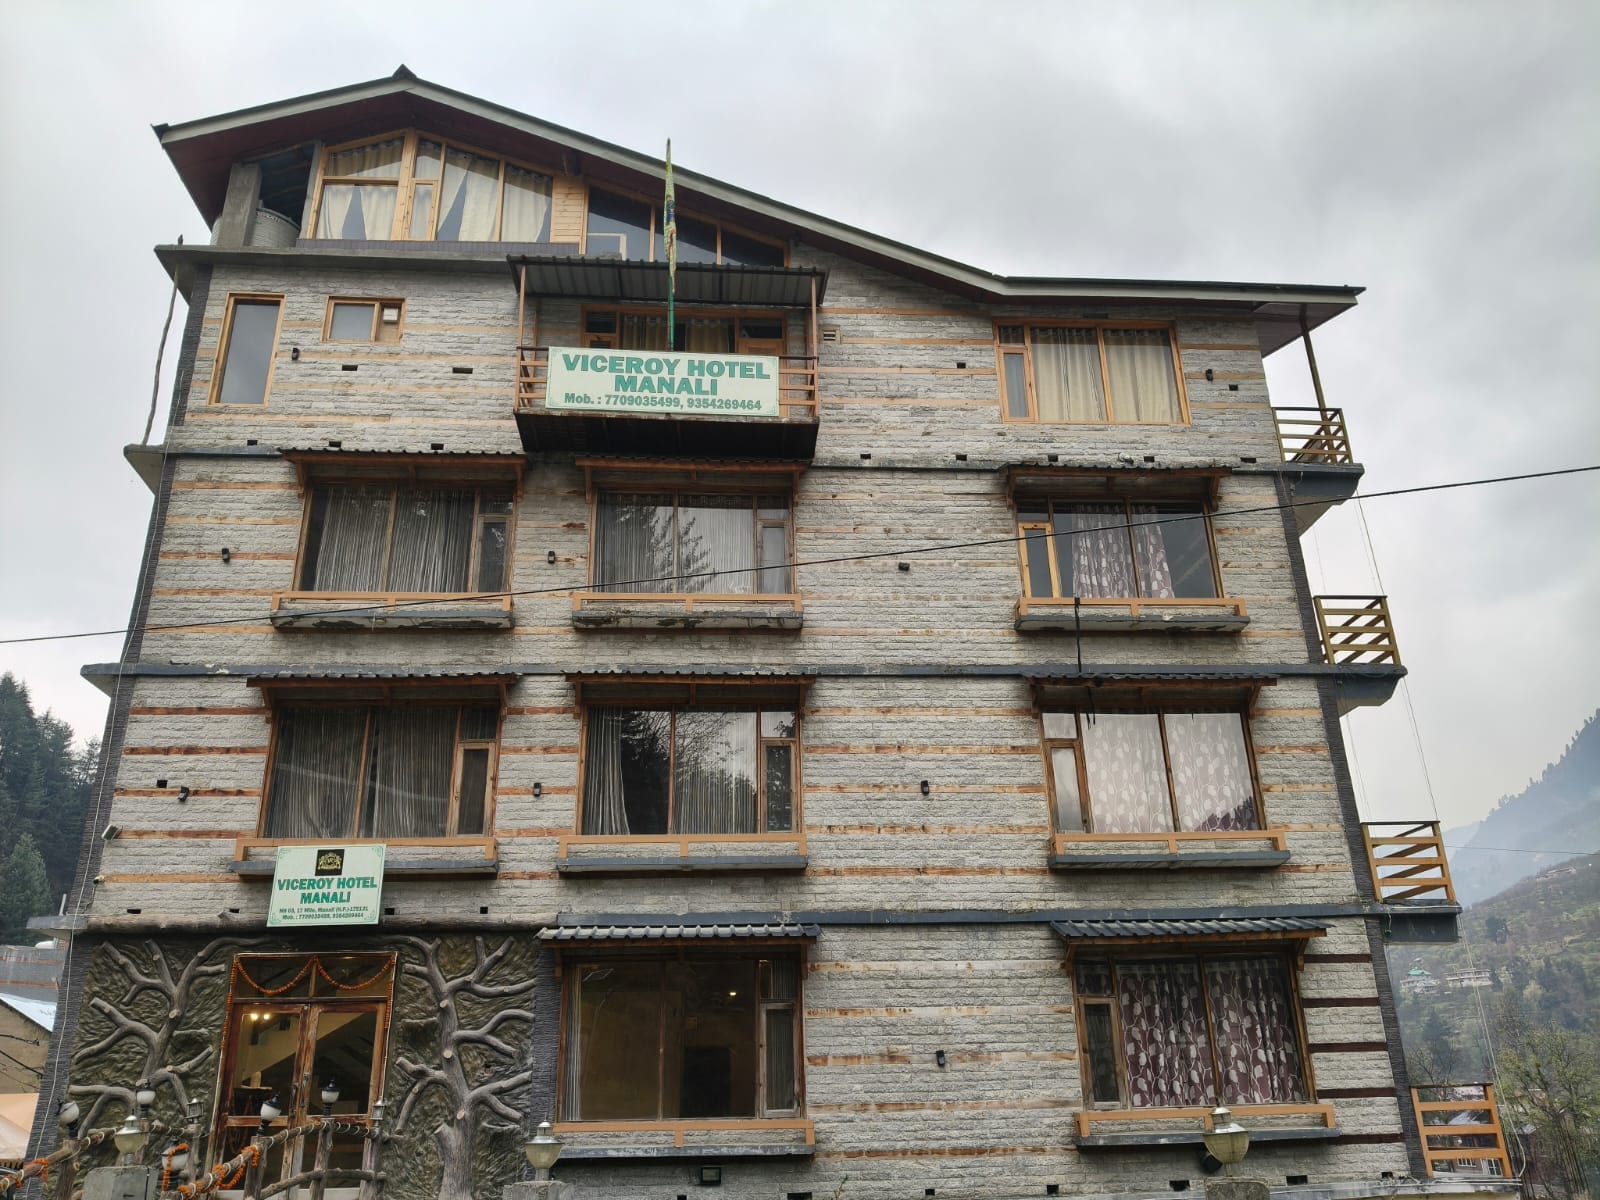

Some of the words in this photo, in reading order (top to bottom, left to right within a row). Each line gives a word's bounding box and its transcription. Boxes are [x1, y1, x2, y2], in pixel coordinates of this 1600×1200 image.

[562, 353, 681, 376] VICEROY
[687, 360, 771, 380] HOTEL
[614, 375, 718, 396] MANALI
[564, 392, 594, 404] Mob.
[605, 394, 684, 410] 7709035499,
[687, 397, 762, 411] 9354269464
[277, 877, 335, 891] VICEROY
[336, 876, 378, 889] HOTEL
[300, 891, 351, 905] MANALI
